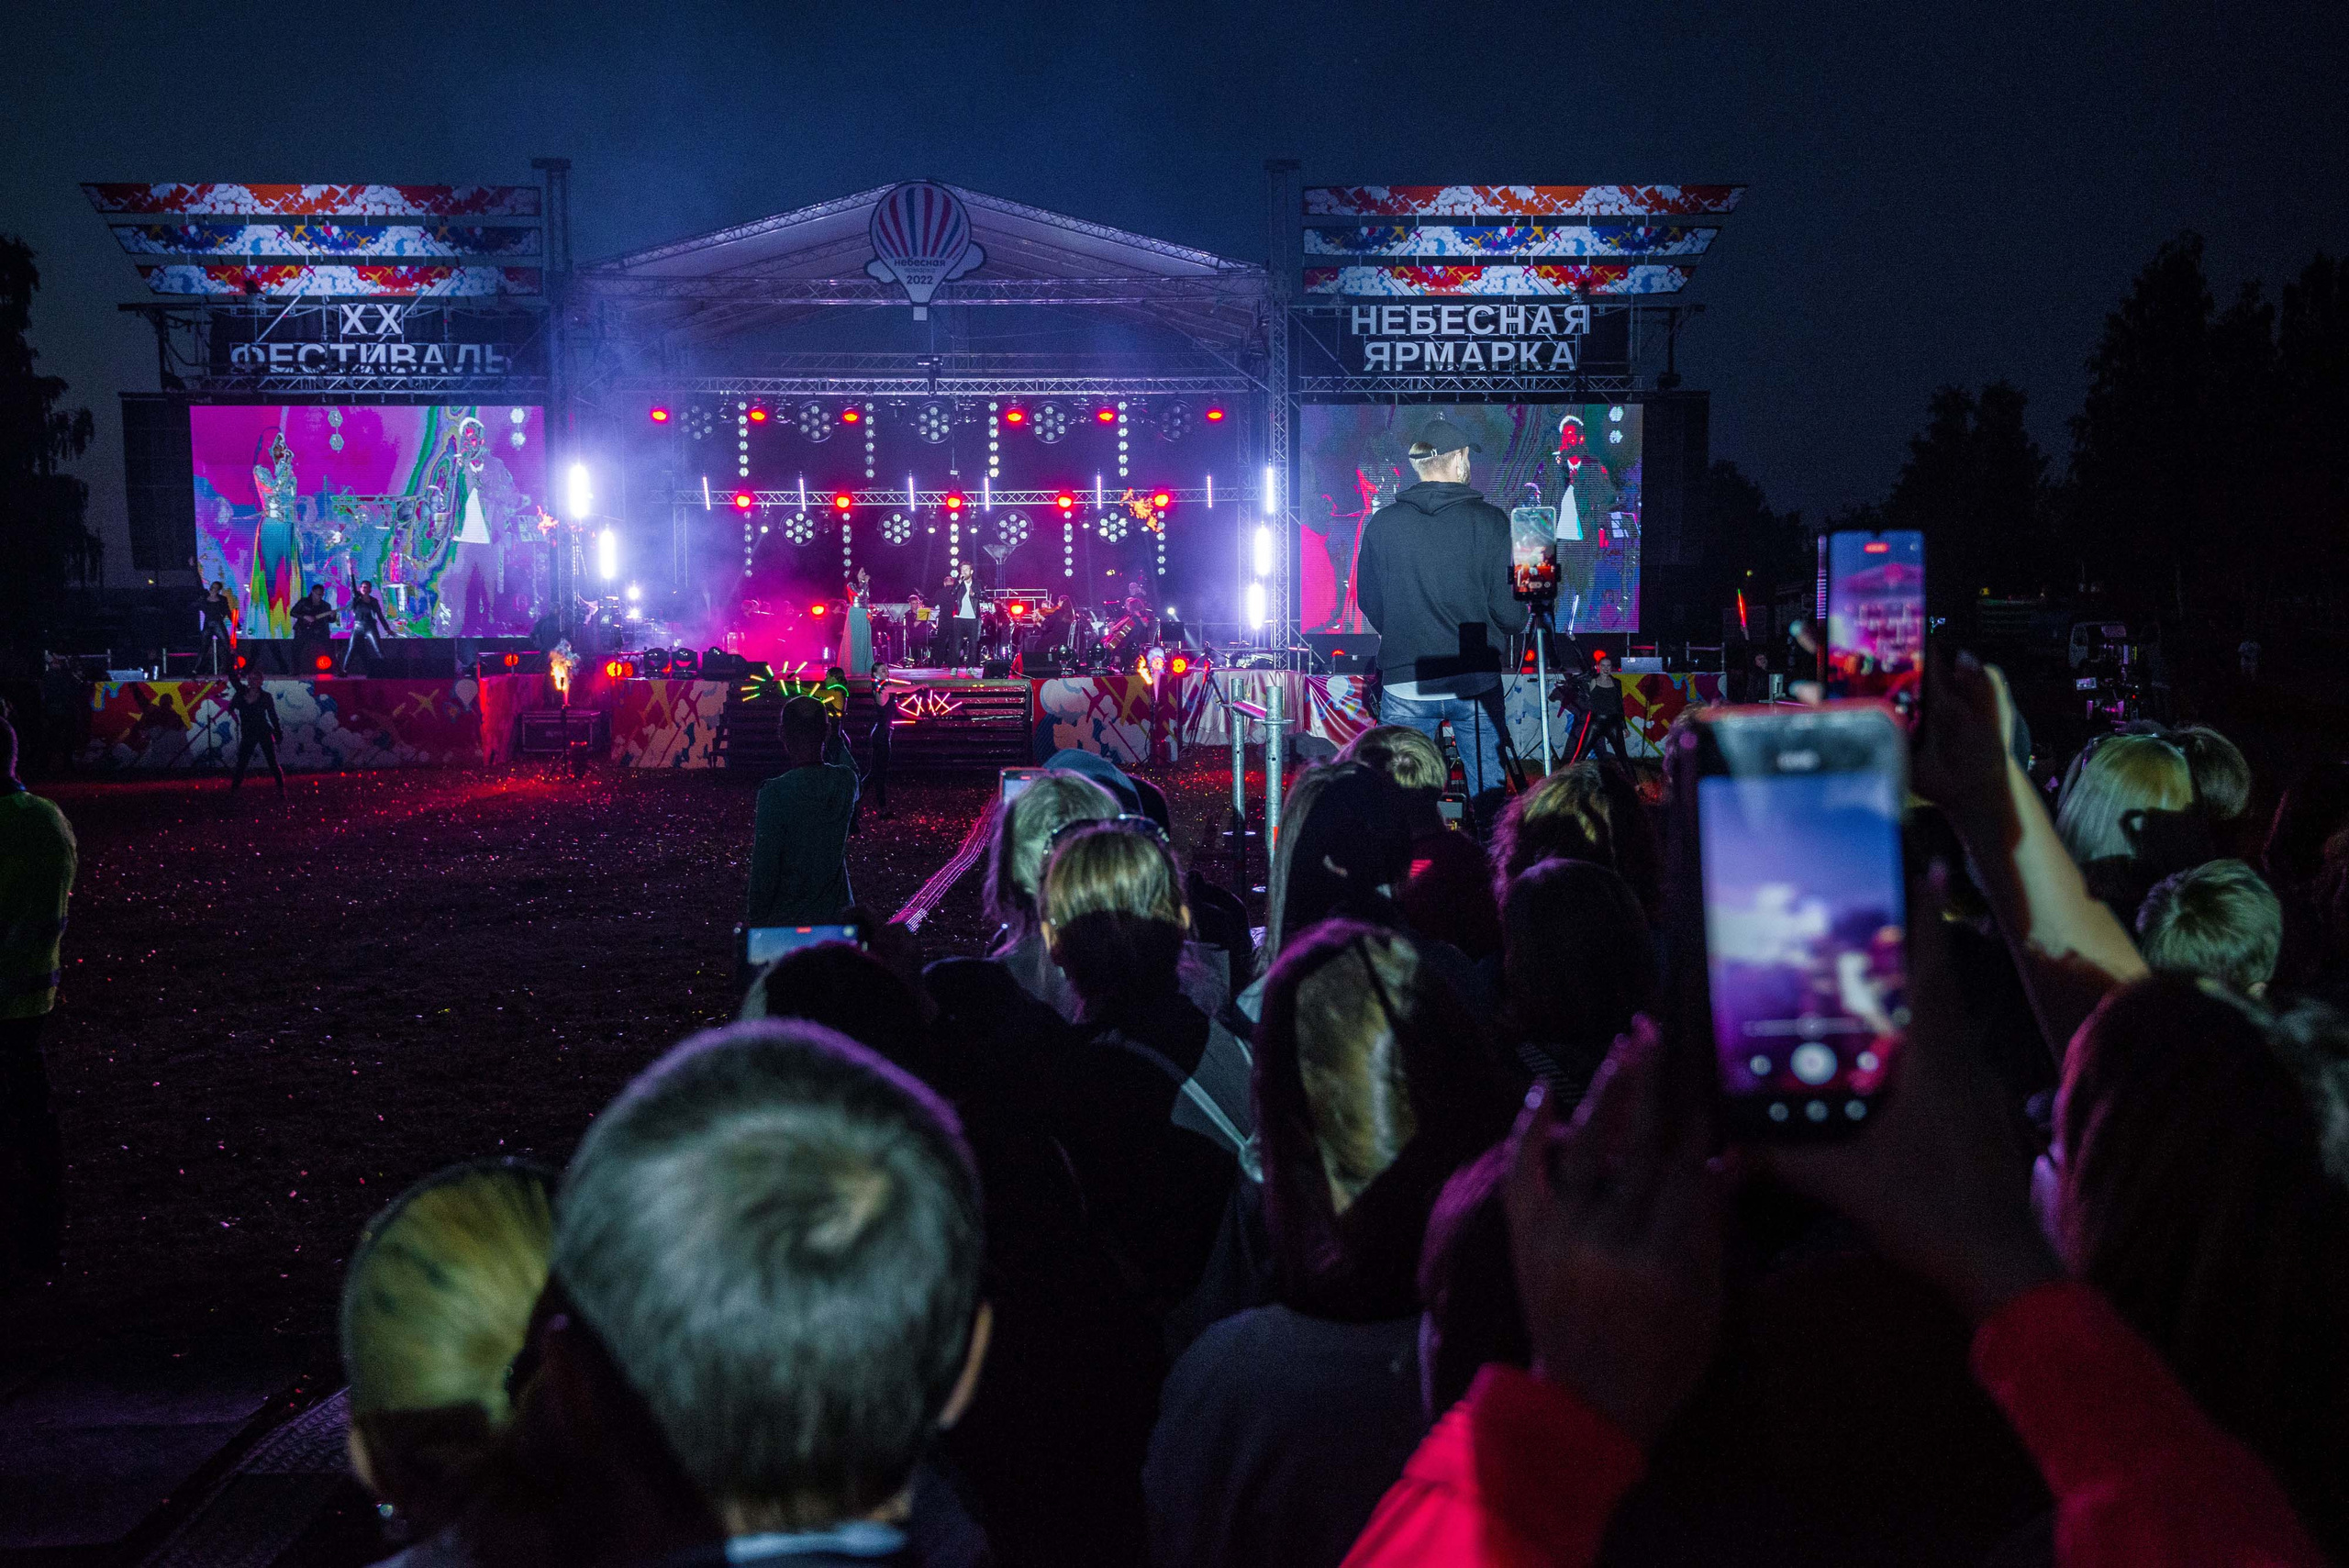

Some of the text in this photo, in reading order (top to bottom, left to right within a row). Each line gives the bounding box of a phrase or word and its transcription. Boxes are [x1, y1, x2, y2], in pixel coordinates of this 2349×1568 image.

[894, 258, 946, 267] небесная
[907, 275, 933, 284] 2022
[340, 304, 403, 335] XX
[1351, 305, 1590, 335] НЕБЕСНАЯ
[230, 342, 512, 374] ФЕСТИВАЛЬ
[1364, 341, 1576, 372] ЯРМАРКА
